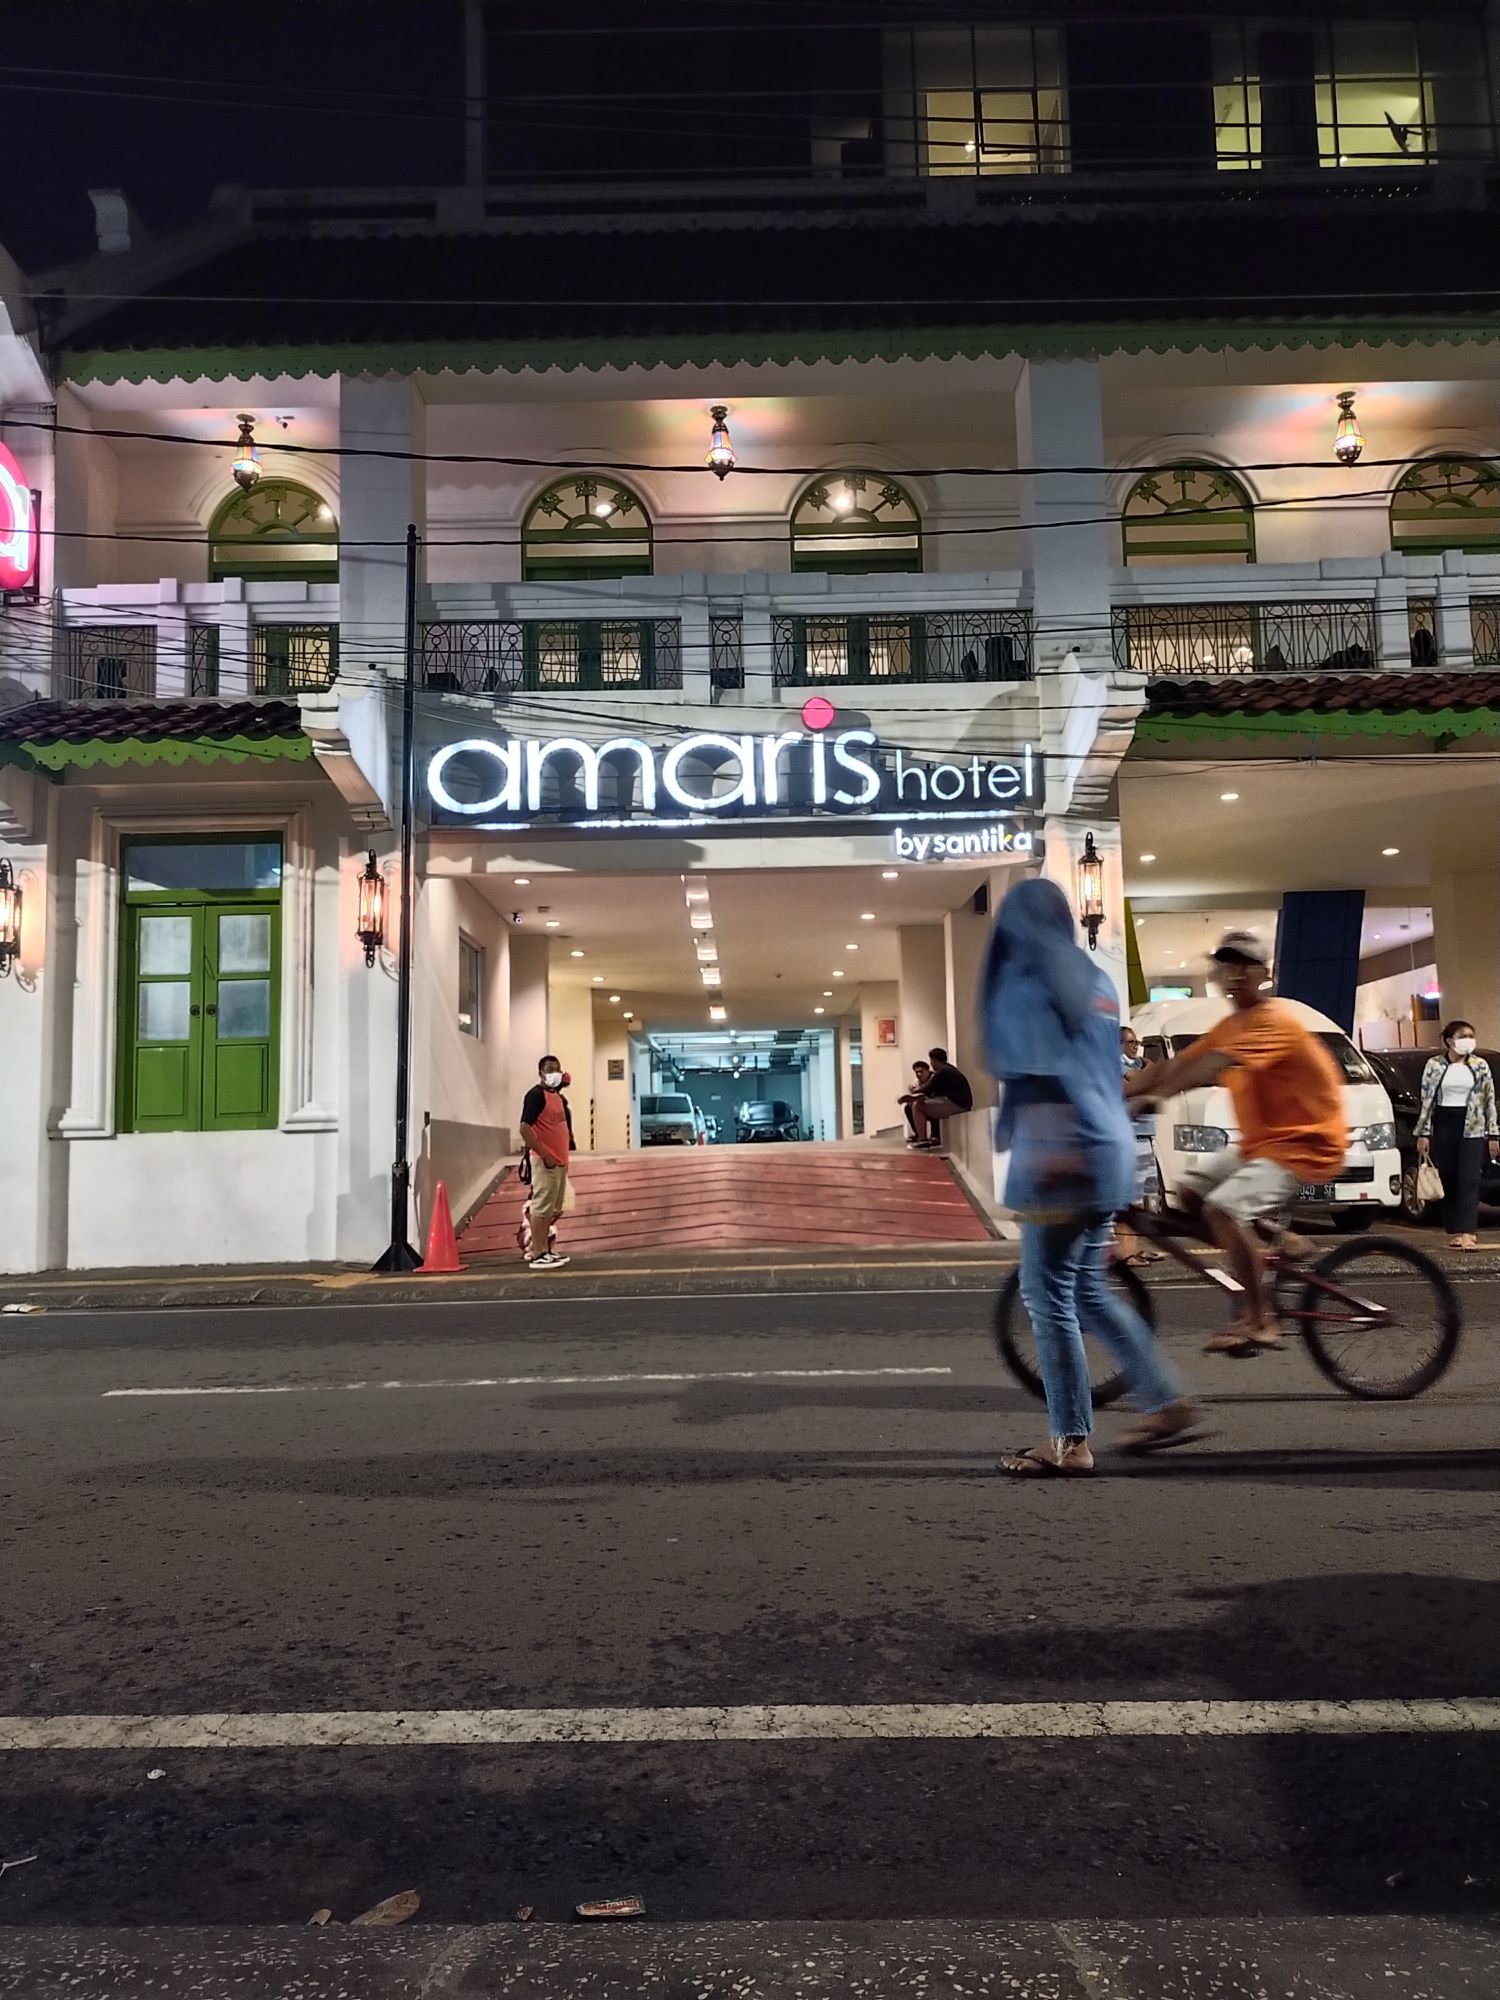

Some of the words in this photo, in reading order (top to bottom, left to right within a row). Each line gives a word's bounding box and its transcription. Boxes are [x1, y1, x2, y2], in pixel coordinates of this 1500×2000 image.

[427, 696, 880, 813] amaris
[895, 743, 1033, 800] hotel
[895, 827, 931, 860] by
[933, 824, 1033, 854] santika
